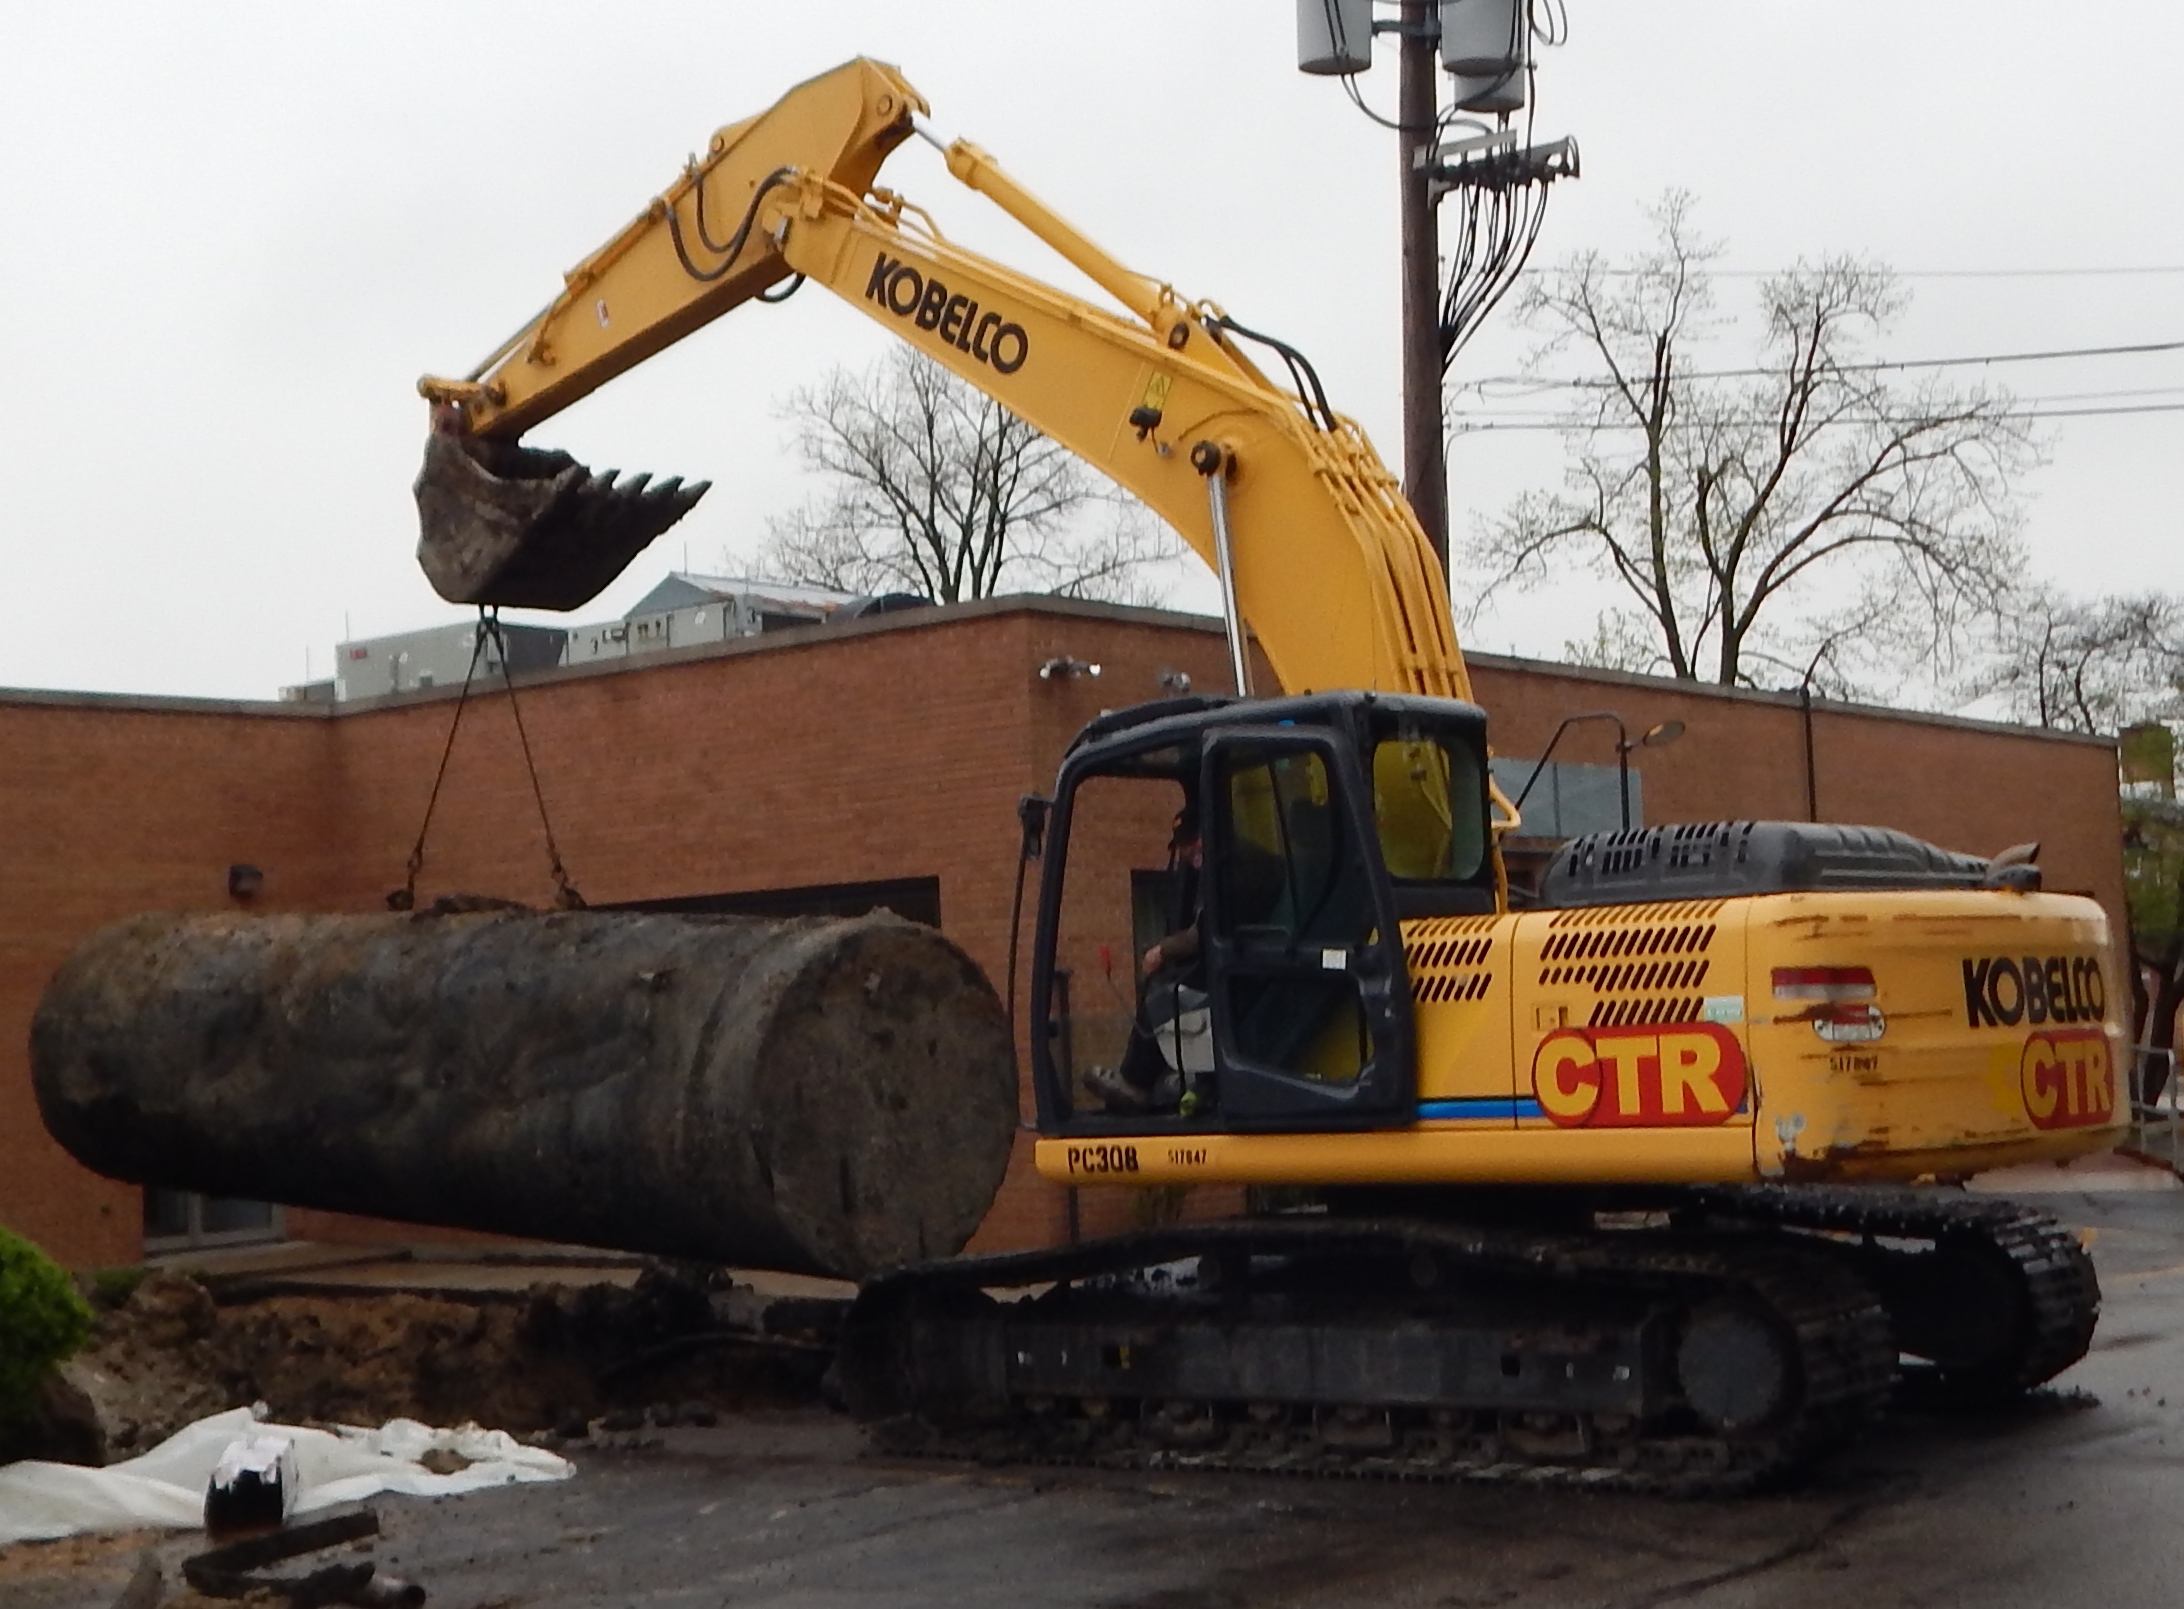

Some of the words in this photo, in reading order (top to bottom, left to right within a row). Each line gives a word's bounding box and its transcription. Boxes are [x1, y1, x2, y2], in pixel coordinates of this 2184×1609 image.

[865, 251, 1028, 373] KOBELCO
[1963, 956, 2105, 1028] KOBELCO
[1535, 1033, 1730, 1117] CTR
[2022, 1038, 2111, 1118] CTR
